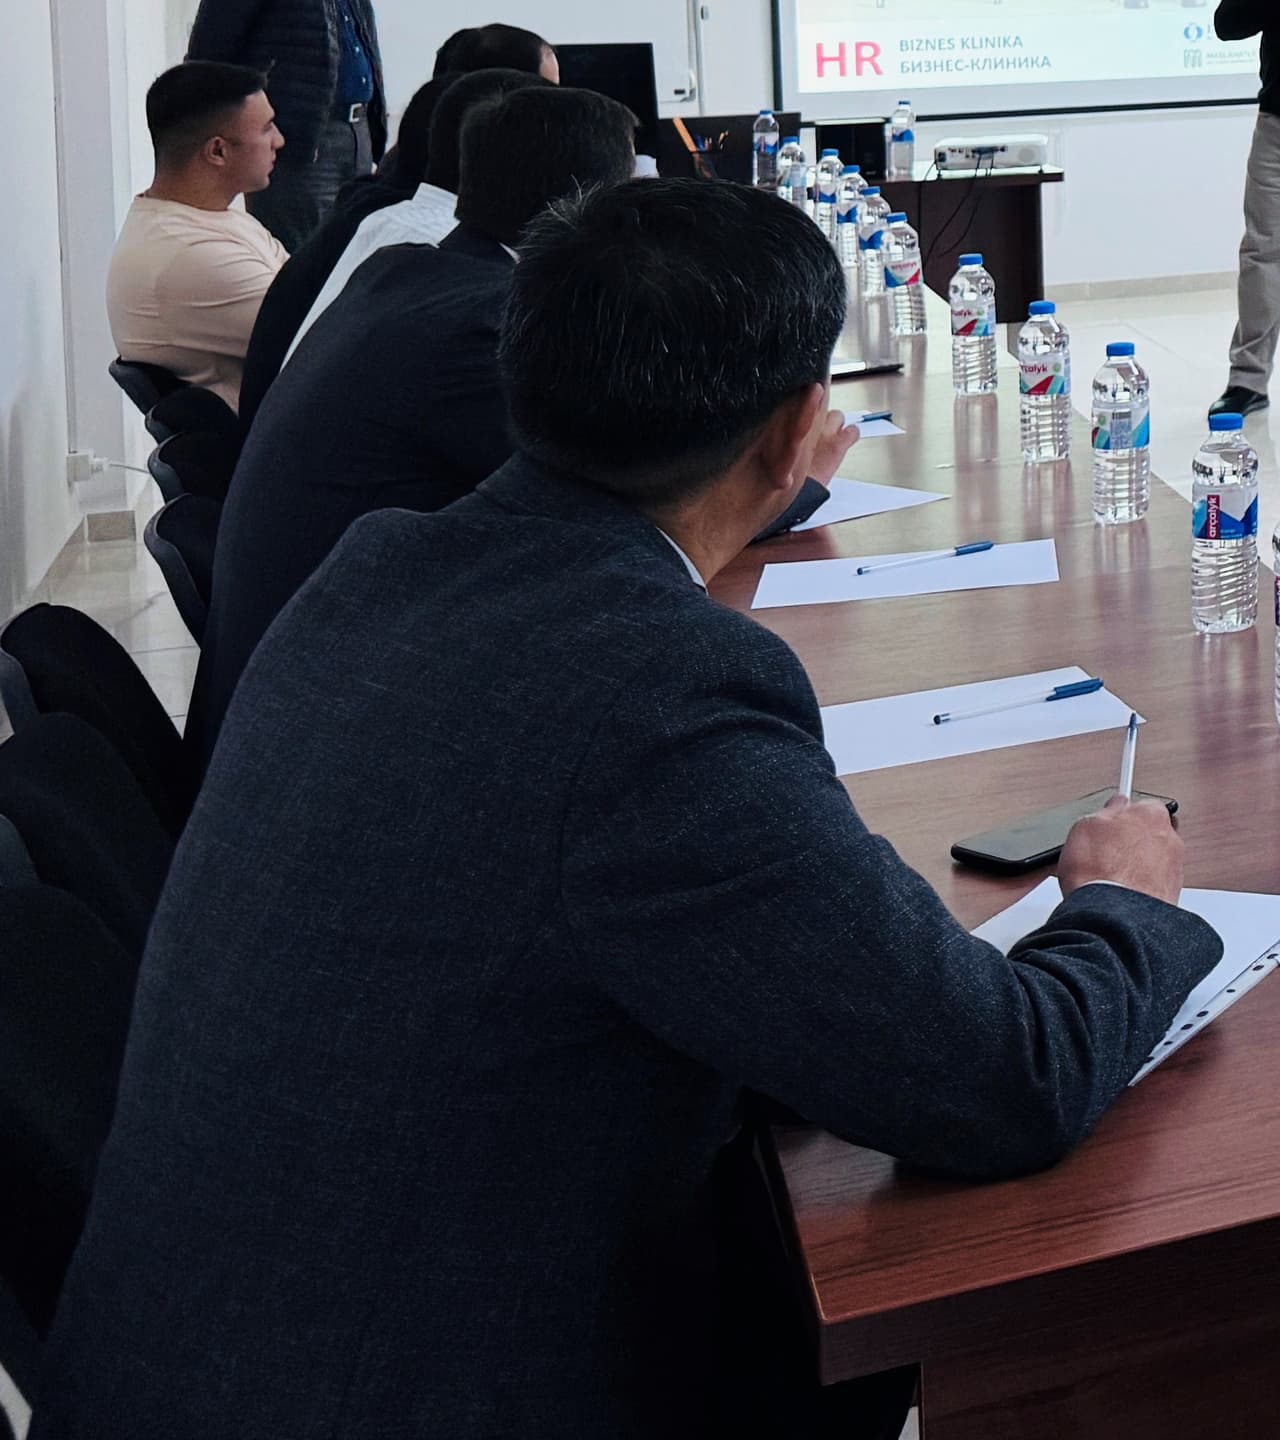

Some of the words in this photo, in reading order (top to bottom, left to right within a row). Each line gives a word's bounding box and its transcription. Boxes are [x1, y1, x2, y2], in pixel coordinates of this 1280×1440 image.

[899, 37, 956, 52] BIZNES
[960, 35, 1024, 50] KLINIKA
[815, 41, 884, 78] HR
[900, 55, 1052, 74] БИЗНЕС-КЛИНИКА
[1208, 496, 1219, 538] arçalyk
